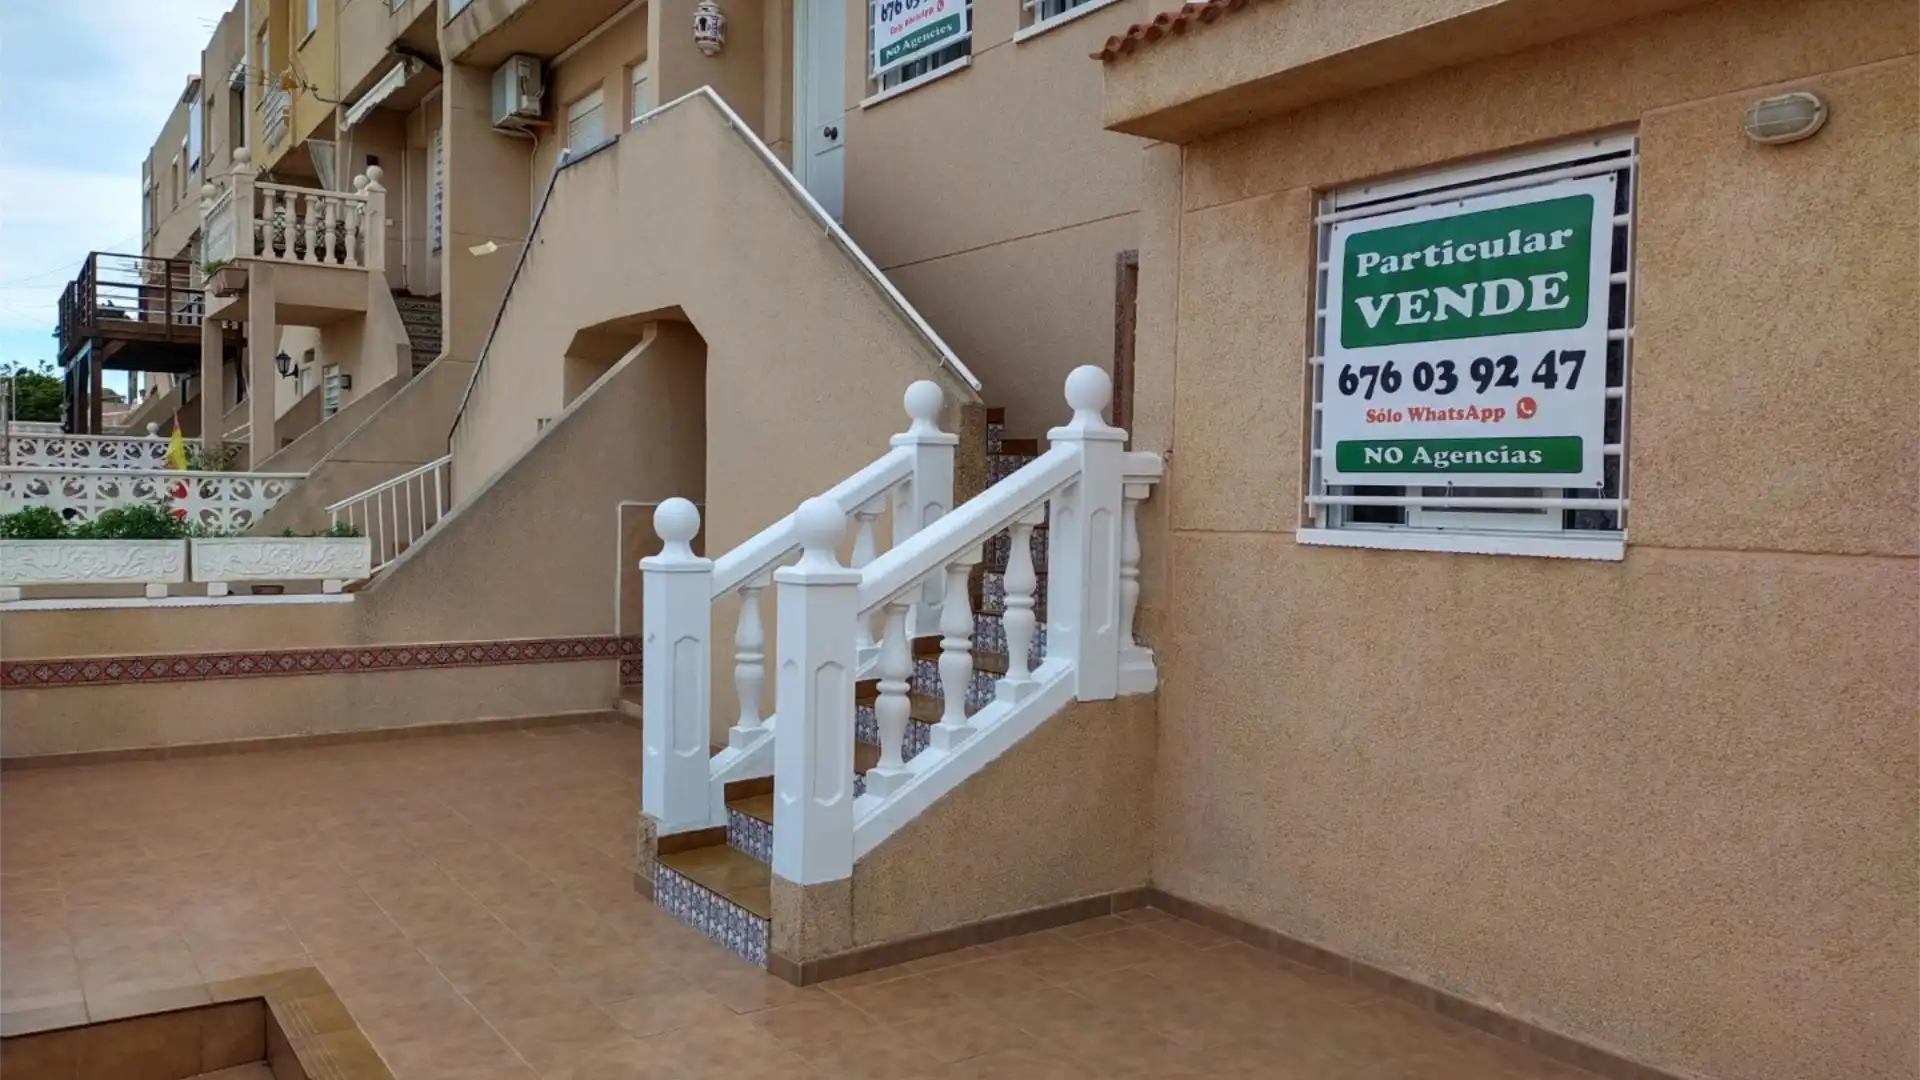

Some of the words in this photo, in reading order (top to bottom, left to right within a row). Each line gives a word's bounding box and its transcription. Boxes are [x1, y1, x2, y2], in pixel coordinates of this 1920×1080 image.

[881, 0, 903, 22] 676
[903, 23, 953, 50] Agencies
[1356, 228, 1574, 278] Particular
[1355, 271, 1570, 329] VENDE
[1338, 360, 1402, 400] 676
[1413, 359, 1459, 396] 03
[1470, 355, 1520, 394] 92
[1531, 350, 1587, 390] 47
[1366, 407, 1402, 423] Sólo
[1407, 404, 1506, 424] WhatsApp
[1364, 447, 1403, 465] NO
[1412, 445, 1543, 469] Agencias
